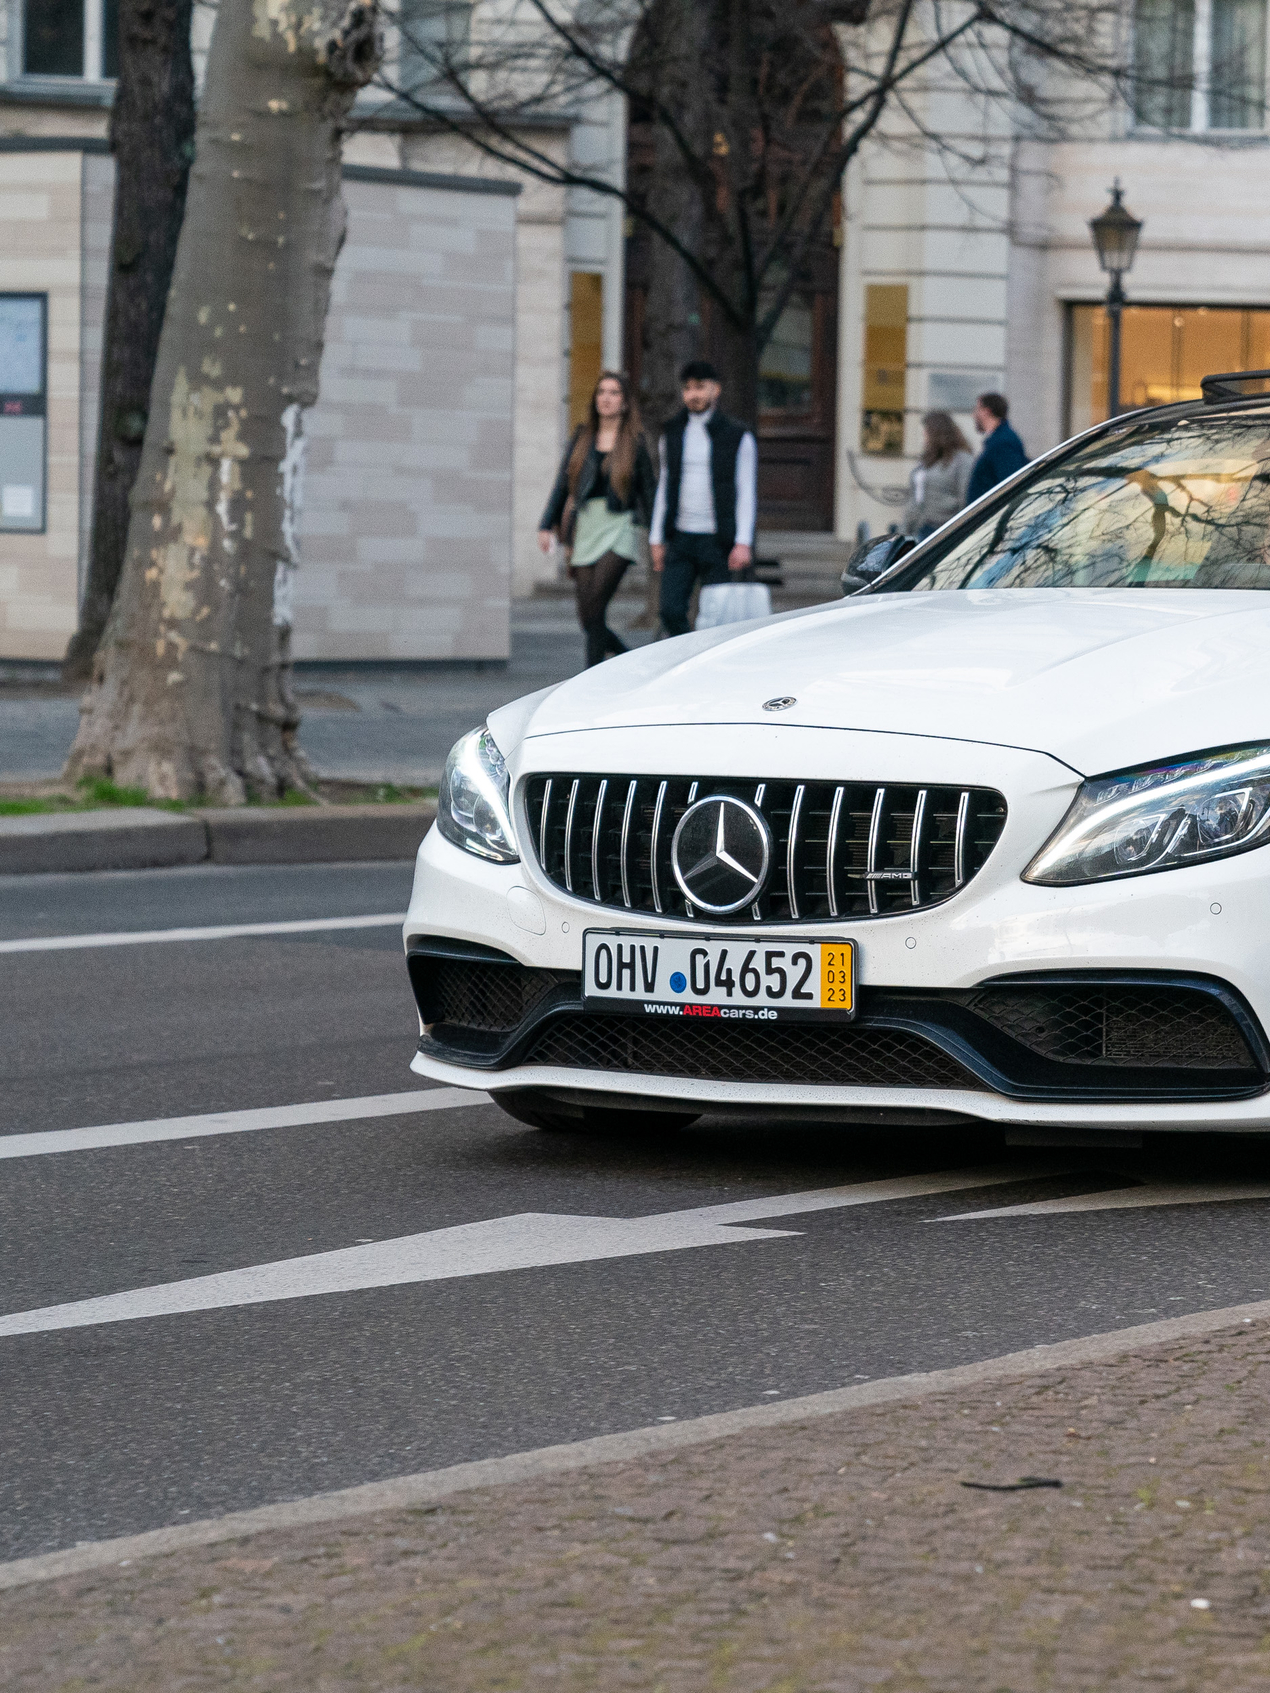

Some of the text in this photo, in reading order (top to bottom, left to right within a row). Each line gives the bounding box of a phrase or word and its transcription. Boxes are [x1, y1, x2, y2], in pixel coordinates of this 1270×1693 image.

[827, 952, 846, 966] 21
[594, 942, 814, 1000] OHV 04652
[827, 970, 846, 984] 03
[827, 988, 847, 1002] 23
[644, 1004, 778, 1020] www.AREAcars.de
